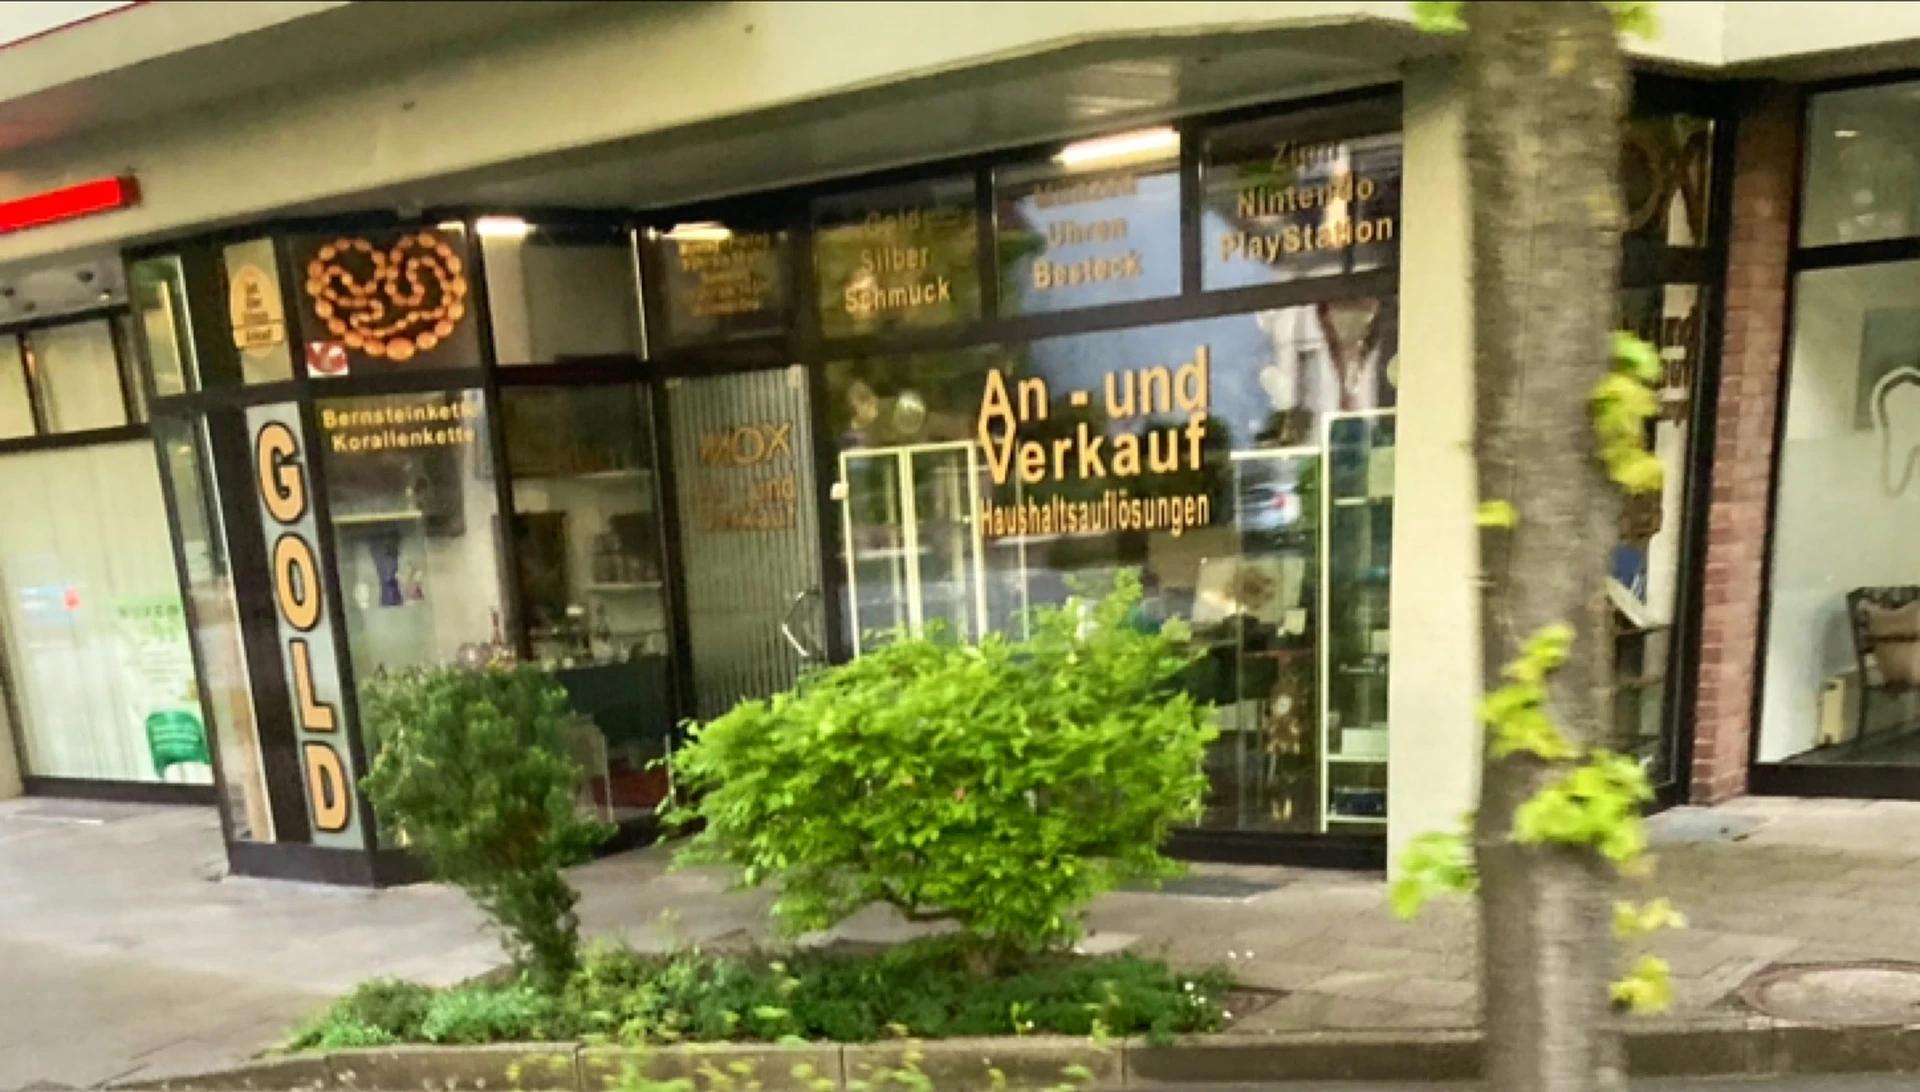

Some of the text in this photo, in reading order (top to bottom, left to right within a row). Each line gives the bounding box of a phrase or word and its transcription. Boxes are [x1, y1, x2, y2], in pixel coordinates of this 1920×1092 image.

[1238, 174, 1374, 217] Nintendo
[862, 247, 929, 272] Silber
[1220, 217, 1393, 264] PlayStation
[1033, 252, 1142, 289] Besteck
[845, 276, 951, 312] Schmuck
[979, 369, 1049, 421] An
[1105, 345, 1209, 418] und
[331, 427, 475, 452] Korallenkette
[980, 411, 1206, 484] Verkauf
[980, 489, 1210, 538] Haushaltsauflösungen
[258, 421, 350, 833] GOLD
